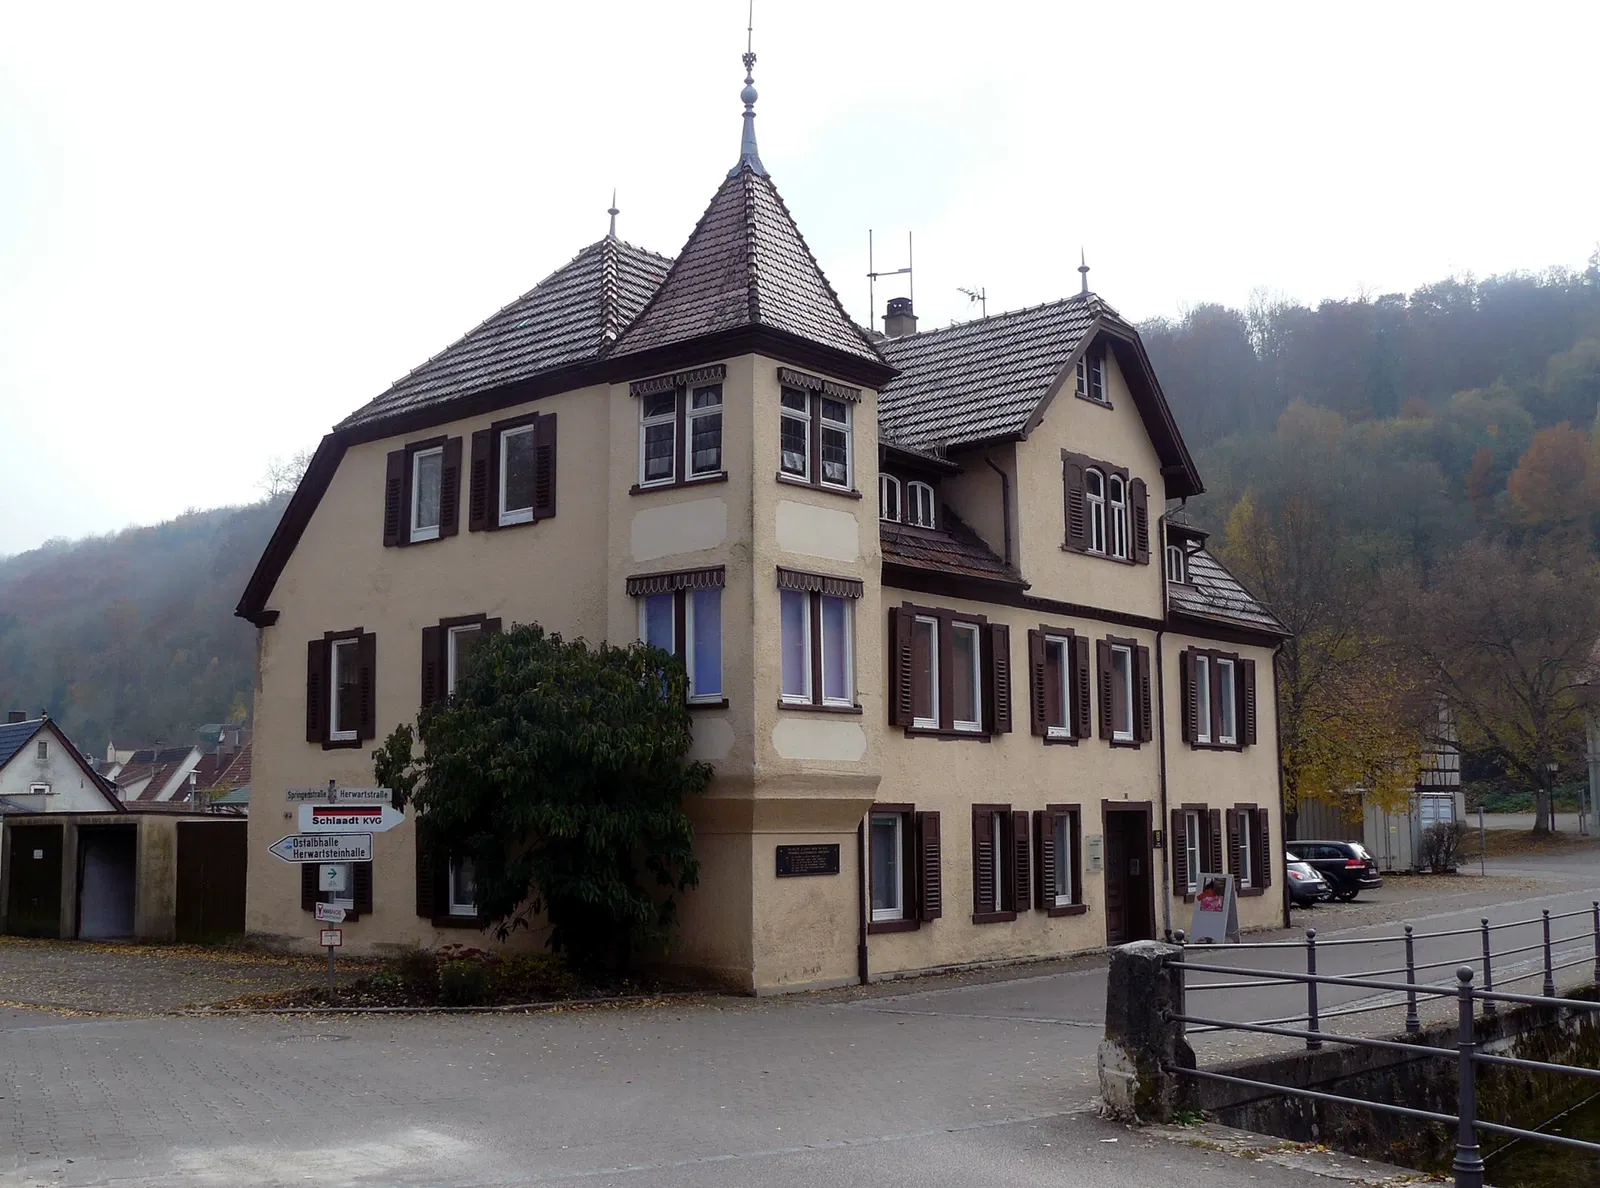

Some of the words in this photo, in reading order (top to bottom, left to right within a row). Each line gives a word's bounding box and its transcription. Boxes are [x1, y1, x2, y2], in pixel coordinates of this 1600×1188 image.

[340, 789, 389, 799] Herwartstraße
[312, 816, 359, 825] Schlaadt
[363, 816, 382, 825] KVG
[293, 837, 339, 848] Ostalbhalle
[293, 847, 366, 859] Herwartsteinhalle
